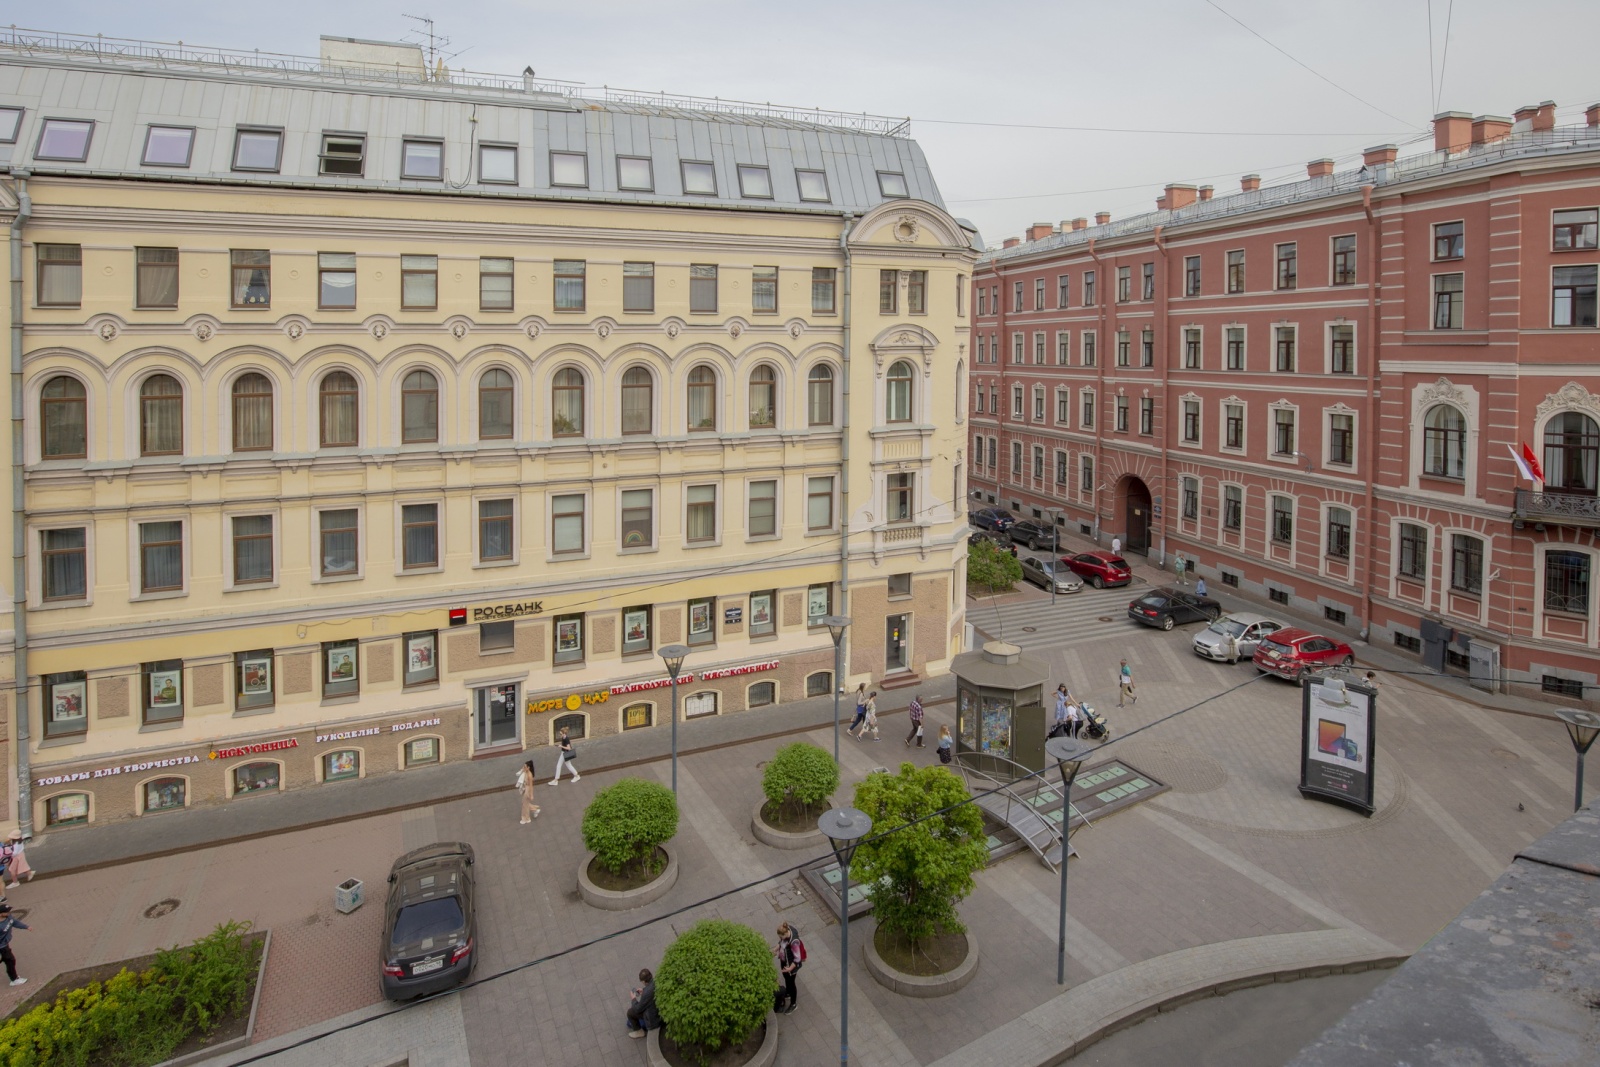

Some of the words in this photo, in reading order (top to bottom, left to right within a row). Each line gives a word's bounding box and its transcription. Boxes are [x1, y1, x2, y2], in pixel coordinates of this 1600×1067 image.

[474, 601, 543, 617] РОСБАНК
[702, 660, 780, 680] МЯСОКОМБИНАТ
[528, 698, 563, 715] МОРЕ
[584, 690, 610, 705] ЧАЯ
[316, 727, 380, 743] РУКОДЕЛИЕ
[391, 718, 441, 732] ПОДАРКИ
[218, 738, 299, 759] ИСКУСНИЦА
[37, 771, 90, 787] ТОВАРЫ
[94, 766, 121, 779] ДЛЯ
[124, 755, 200, 773] ТВОРЧЕСТВА
